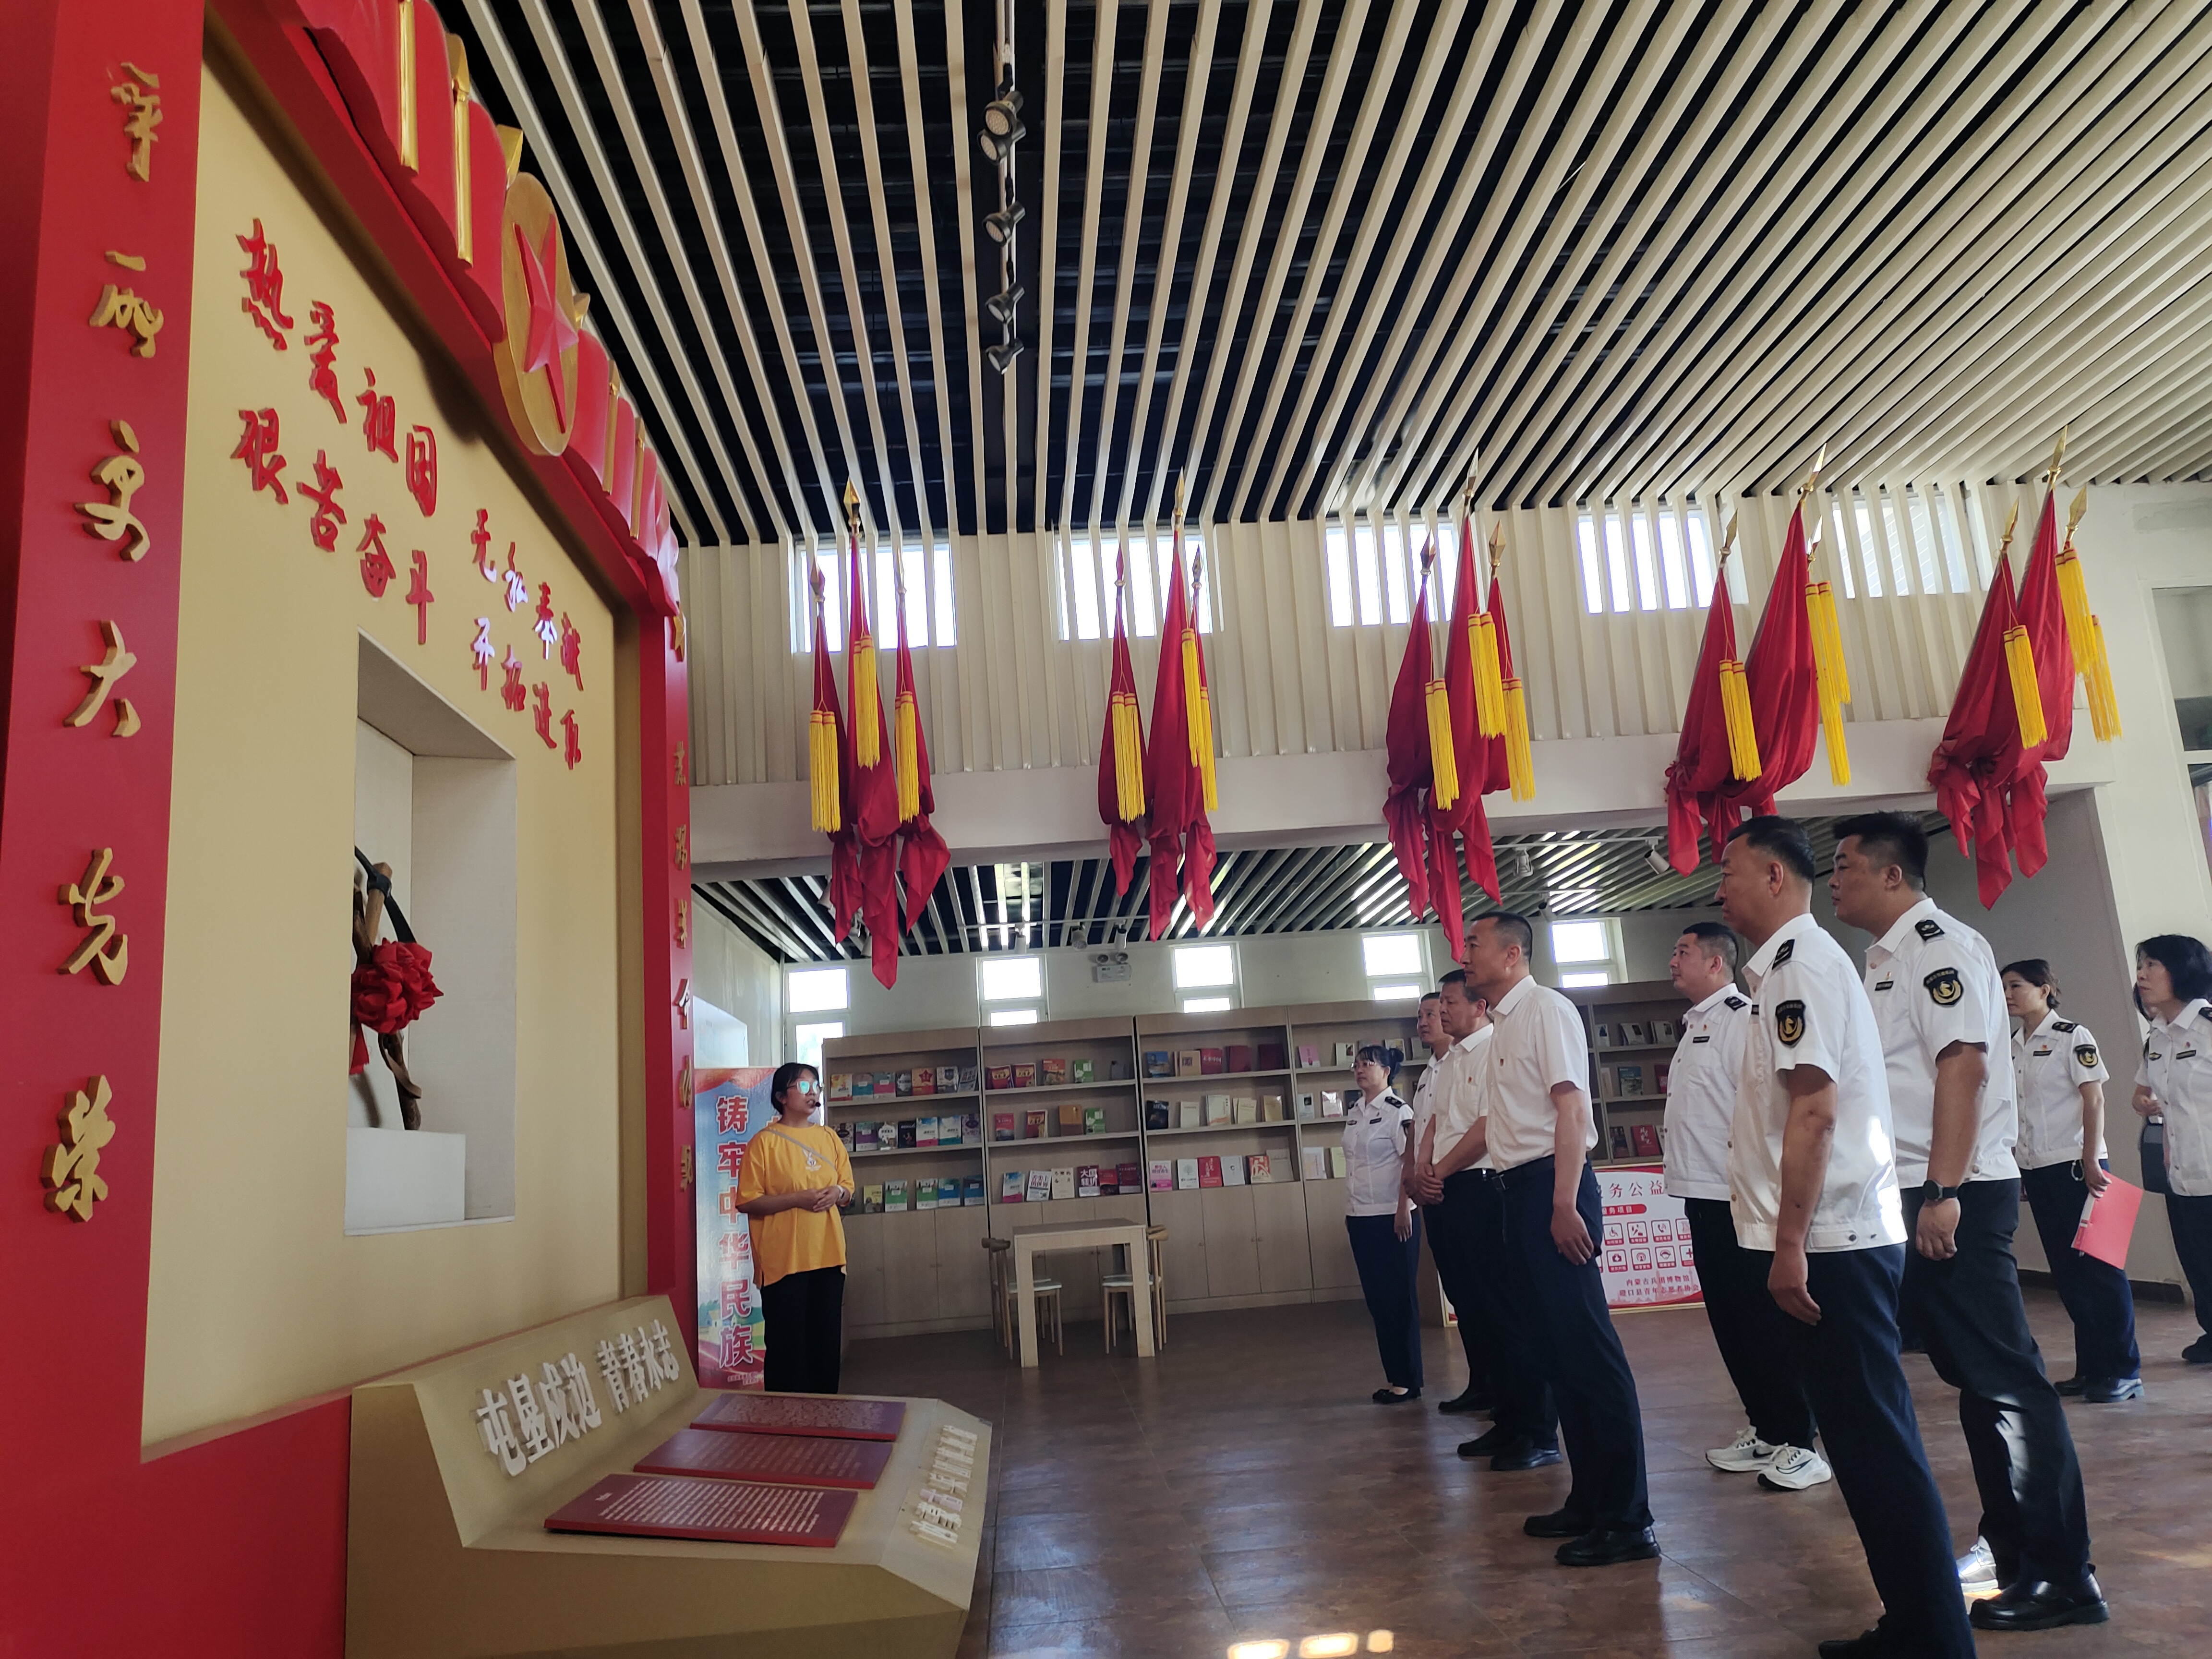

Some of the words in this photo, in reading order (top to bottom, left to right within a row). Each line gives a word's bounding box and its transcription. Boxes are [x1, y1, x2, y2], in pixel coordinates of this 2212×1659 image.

[237, 218, 438, 517] 热爱祖国
[230, 408, 434, 645] 艰苦奋斗
[717, 1095, 754, 1370] 铸牢中华民族
[1601, 1180, 1664, 1199] 务公益
[477, 1352, 603, 1477] 屯垦戍边
